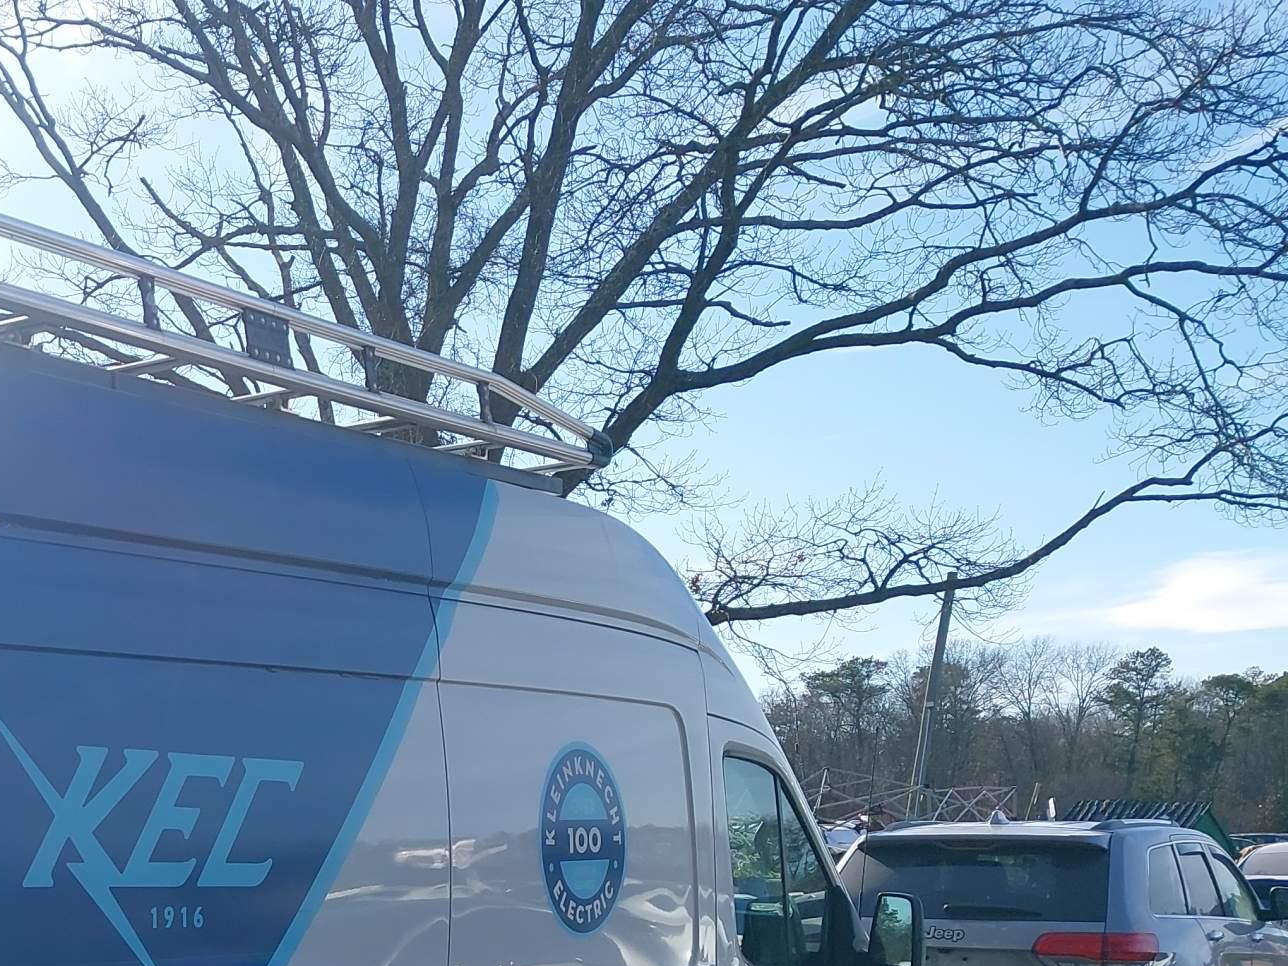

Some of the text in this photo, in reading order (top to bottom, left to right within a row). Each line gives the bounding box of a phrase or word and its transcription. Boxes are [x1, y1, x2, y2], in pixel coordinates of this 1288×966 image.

[545, 756, 622, 846] KLEINKNECHT
[567, 826, 602, 855] 100
[553, 880, 615, 924] ELECTRIC
[150, 905, 205, 929] 1916
[925, 926, 965, 942] Jeep
